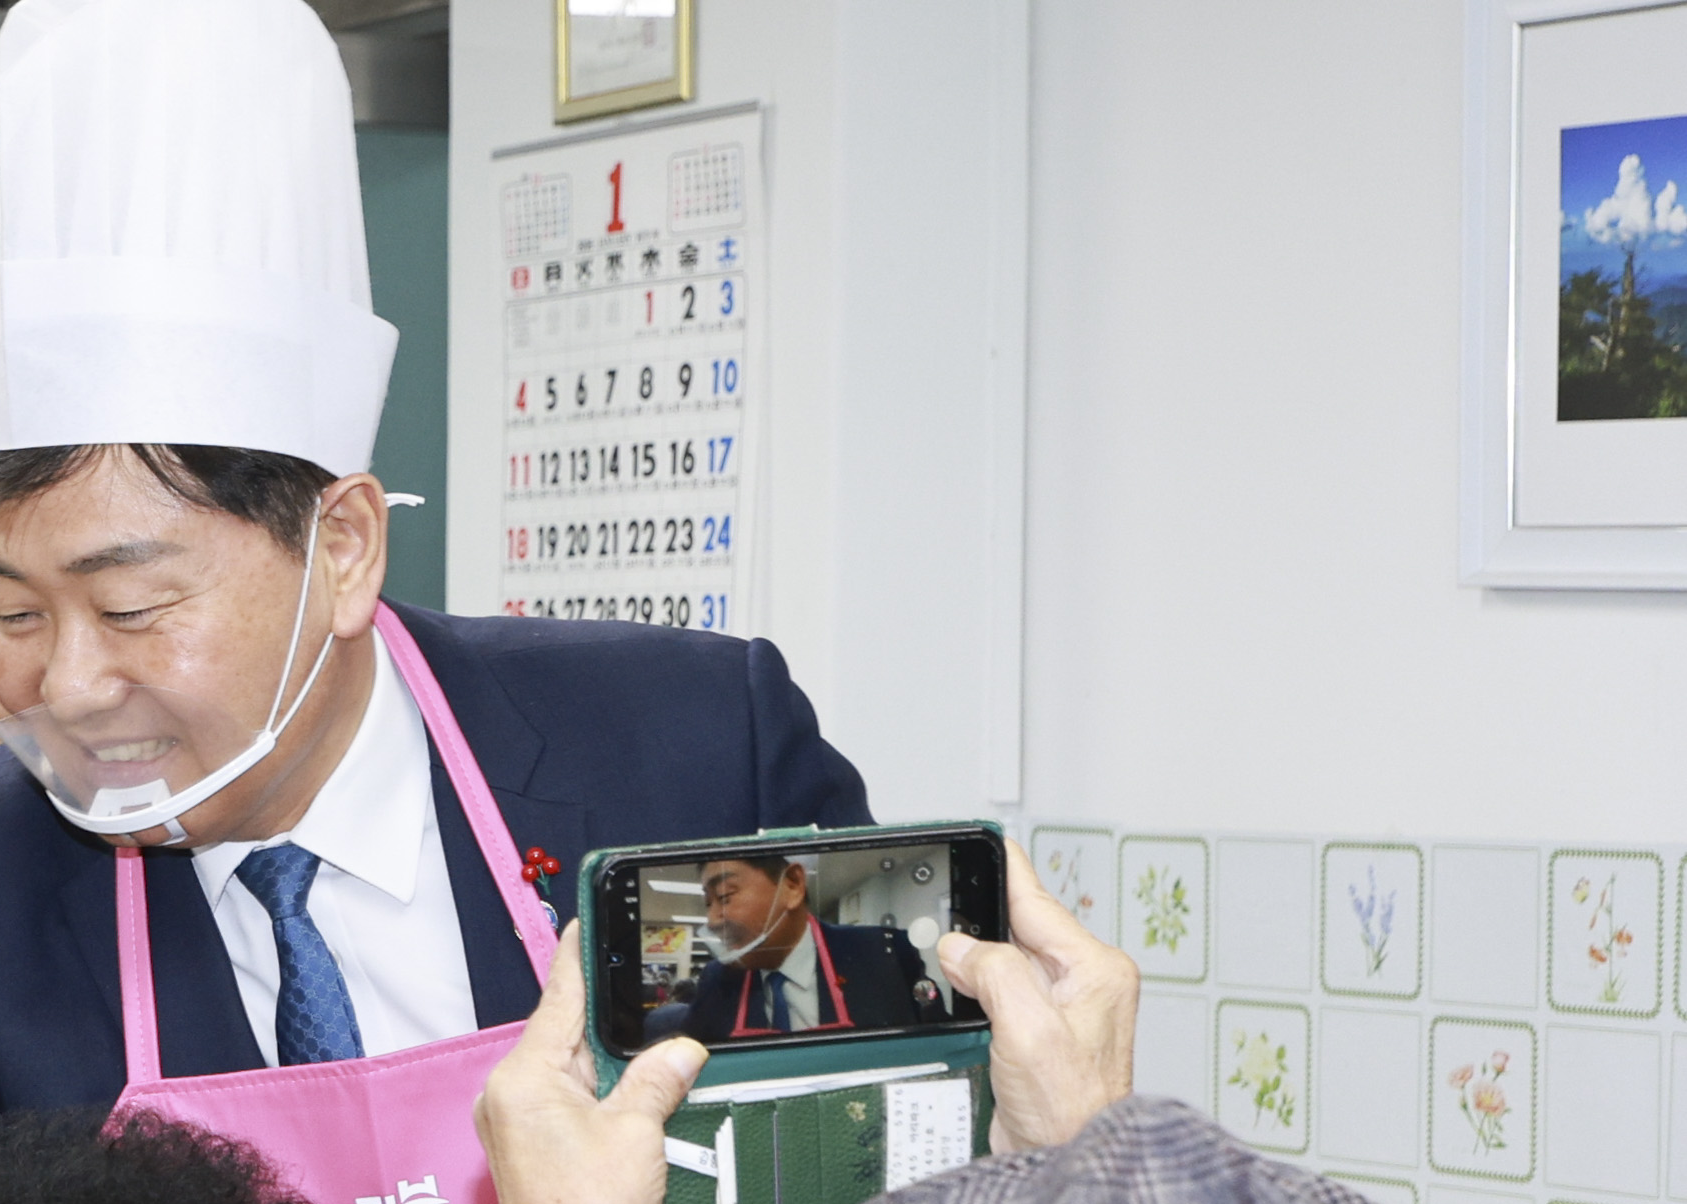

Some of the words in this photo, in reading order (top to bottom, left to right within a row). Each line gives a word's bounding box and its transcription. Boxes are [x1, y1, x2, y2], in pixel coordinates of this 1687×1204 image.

[607, 161, 624, 233] 1
[717, 236, 737, 262] 土
[645, 291, 653, 325] 1
[681, 285, 695, 319] 2
[721, 280, 733, 315] 3
[515, 380, 527, 412] 4
[546, 377, 556, 411] 5
[576, 372, 587, 406] 6
[606, 369, 617, 404] 7
[639, 366, 653, 399] 8
[679, 363, 693, 397] 9
[713, 359, 738, 395] 10
[511, 454, 530, 487] 11
[540, 451, 560, 485] 12
[570, 449, 589, 482] 13
[599, 445, 619, 480] 14
[631, 443, 656, 477] 15
[669, 440, 695, 475] 16
[708, 436, 733, 473] 17
[507, 527, 528, 559] 18
[537, 525, 558, 558] 19
[566, 523, 590, 558] 20
[597, 521, 618, 557] 21
[628, 519, 655, 553] 22
[664, 518, 694, 553] 23
[702, 515, 731, 551] 24
[664, 596, 690, 627] 30
[701, 594, 727, 629] 31
